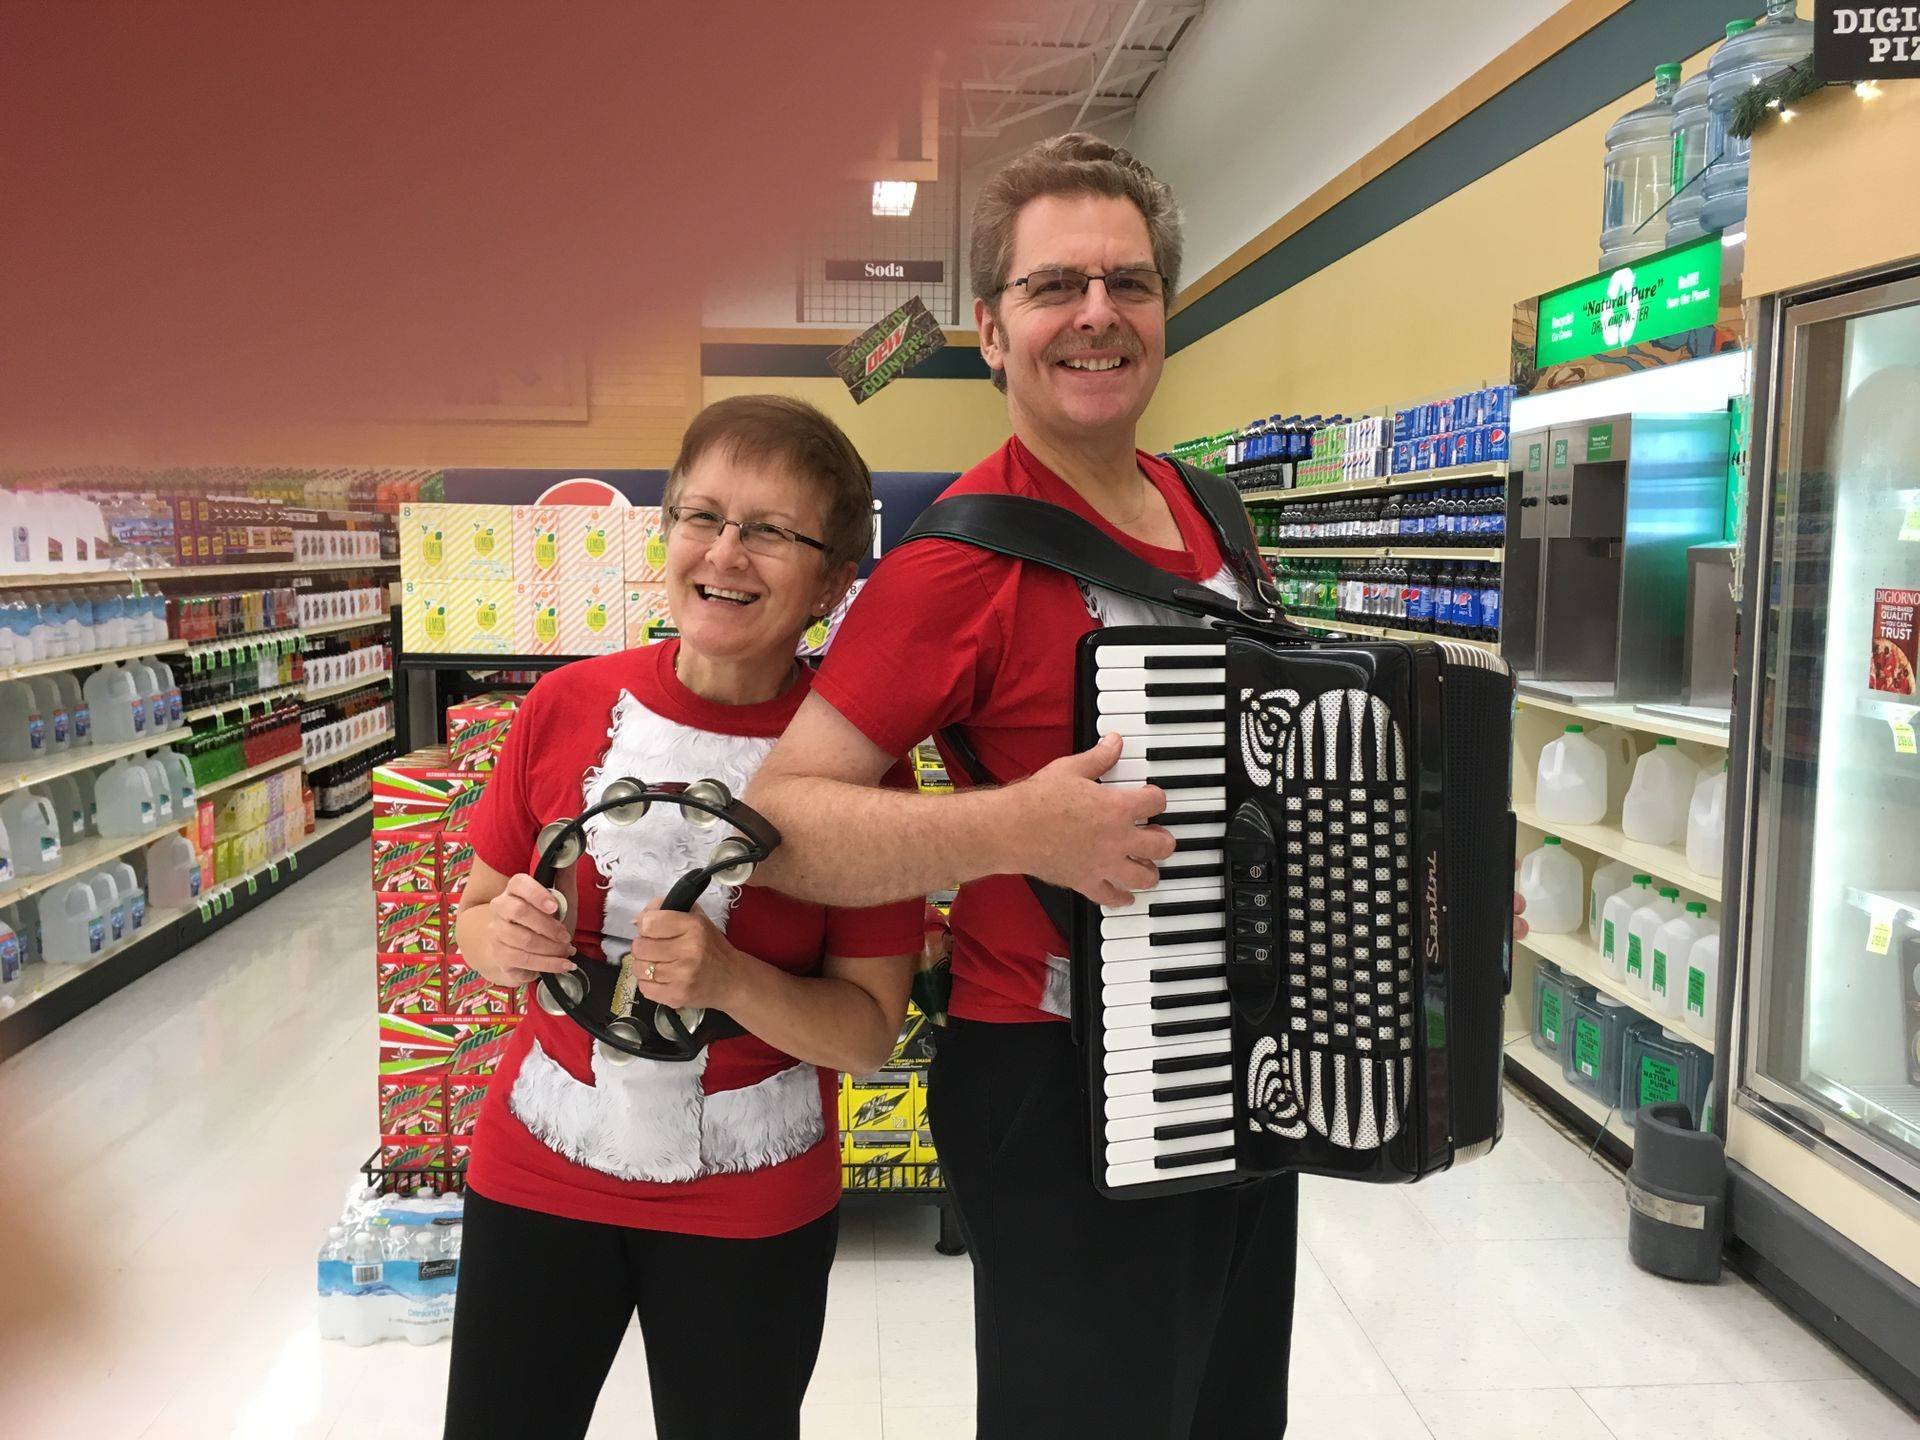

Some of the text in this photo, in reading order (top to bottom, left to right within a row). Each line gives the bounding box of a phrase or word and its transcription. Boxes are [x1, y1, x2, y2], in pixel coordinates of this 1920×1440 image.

[1833, 7, 1920, 34] DIGI
[864, 263, 905, 278] Soda
[862, 330, 925, 395] COUNTRY
[404, 507, 411, 517] 8
[517, 509, 524, 519] 8
[628, 510, 636, 520] 8
[406, 583, 414, 592] 8
[849, 586, 857, 595] 8
[1876, 590, 1920, 605] DIGIORNO
[1881, 611, 1914, 621] QUALITY
[1881, 626, 1913, 640] TRUST
[416, 878, 429, 890] 12
[1426, 850, 1439, 964] Santini
[422, 939, 435, 951] 12
[423, 1000, 435, 1011] 12
[490, 1001, 502, 1012] 12
[1643, 1070, 1676, 1087] NATURAL
[1650, 1080, 1669, 1091] PURE
[424, 1121, 436, 1132] 12
